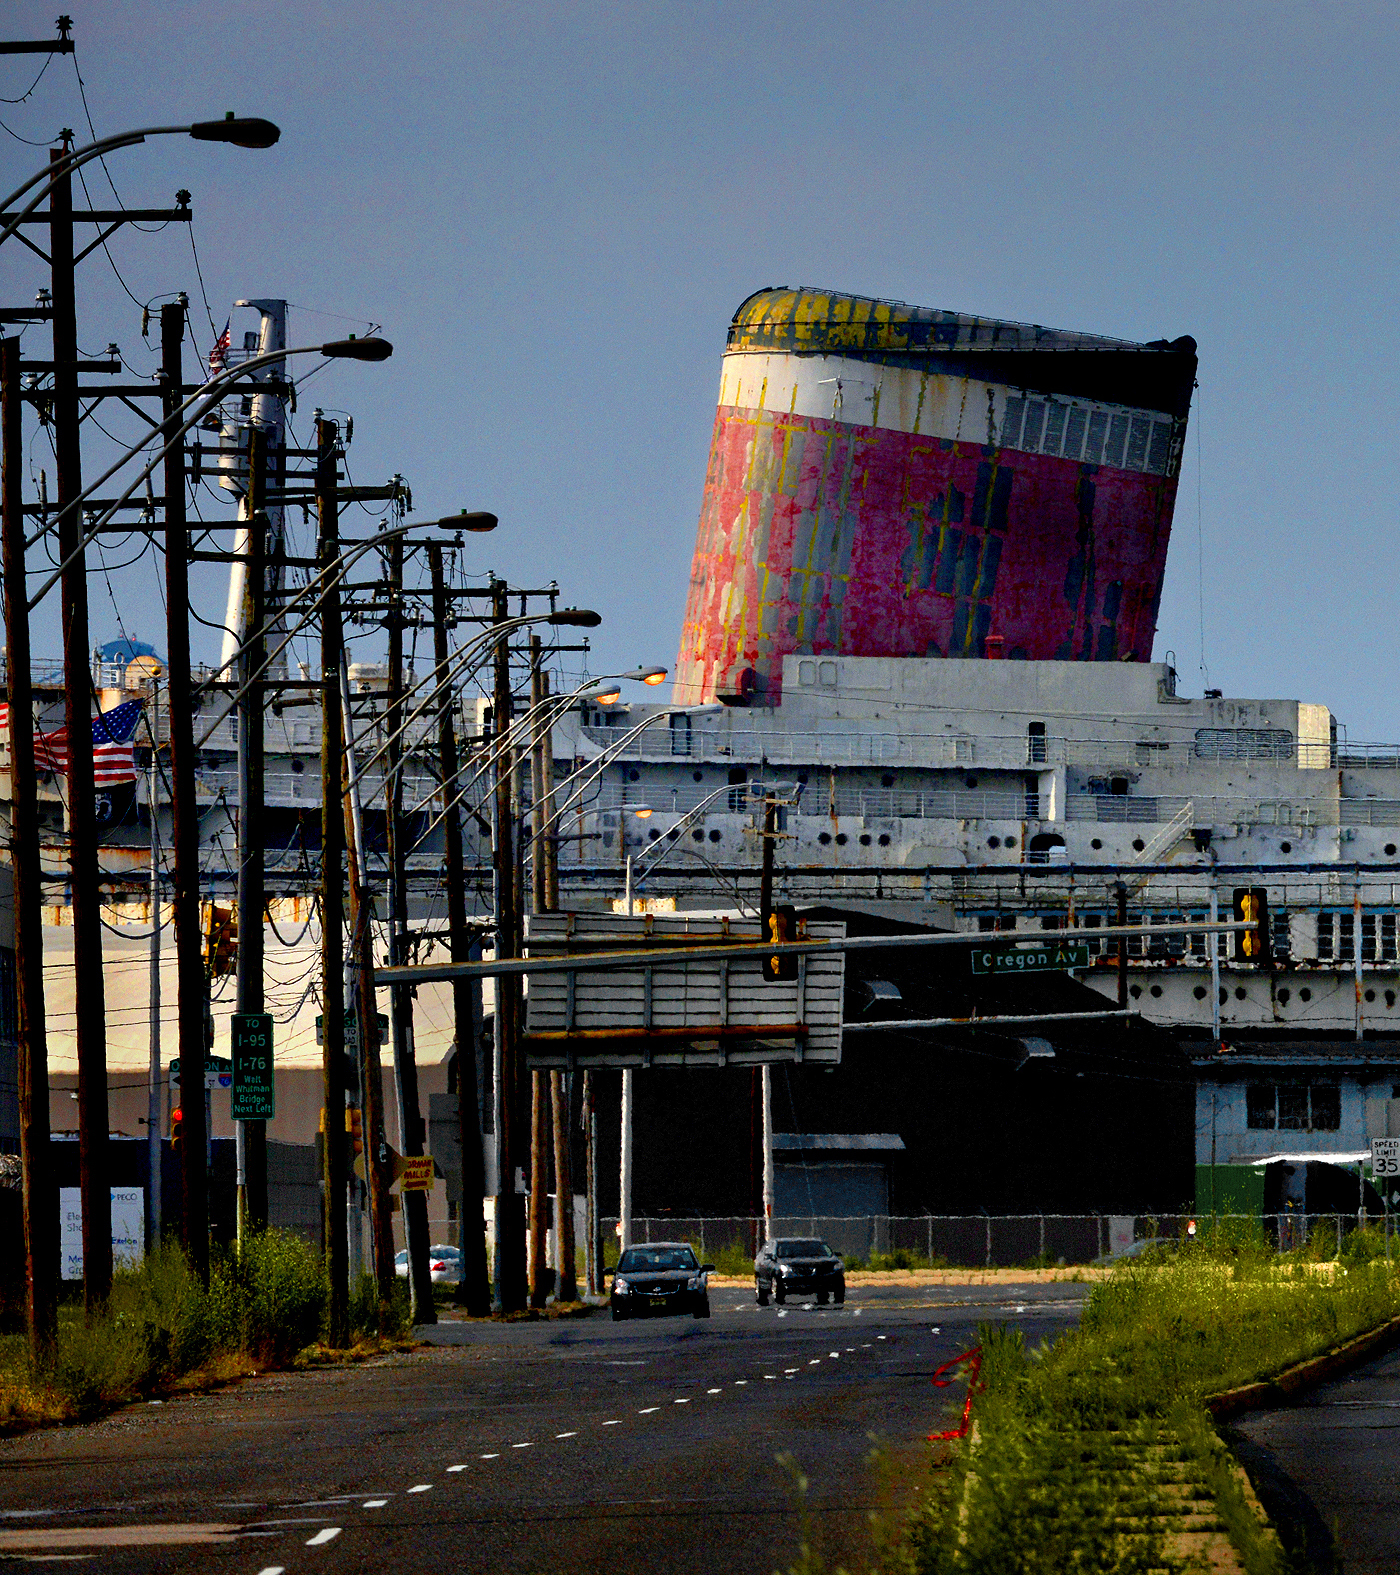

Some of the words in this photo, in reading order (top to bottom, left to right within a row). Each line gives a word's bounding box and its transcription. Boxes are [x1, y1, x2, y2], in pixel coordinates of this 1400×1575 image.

[982, 953, 1047, 969] Oregon
[1055, 950, 1077, 963] Av
[246, 1019, 259, 1028] TO
[238, 1034, 266, 1047] I-95
[239, 1057, 266, 1070] I-76
[236, 1085, 270, 1093] Whitman
[239, 1094, 265, 1104] Bridge
[234, 1104, 253, 1113] Next
[255, 1103, 271, 1113] Left
[1375, 1158, 1398, 1172] 35
[403, 1169, 431, 1179] MILLS
[117, 1193, 138, 1201] PECO
